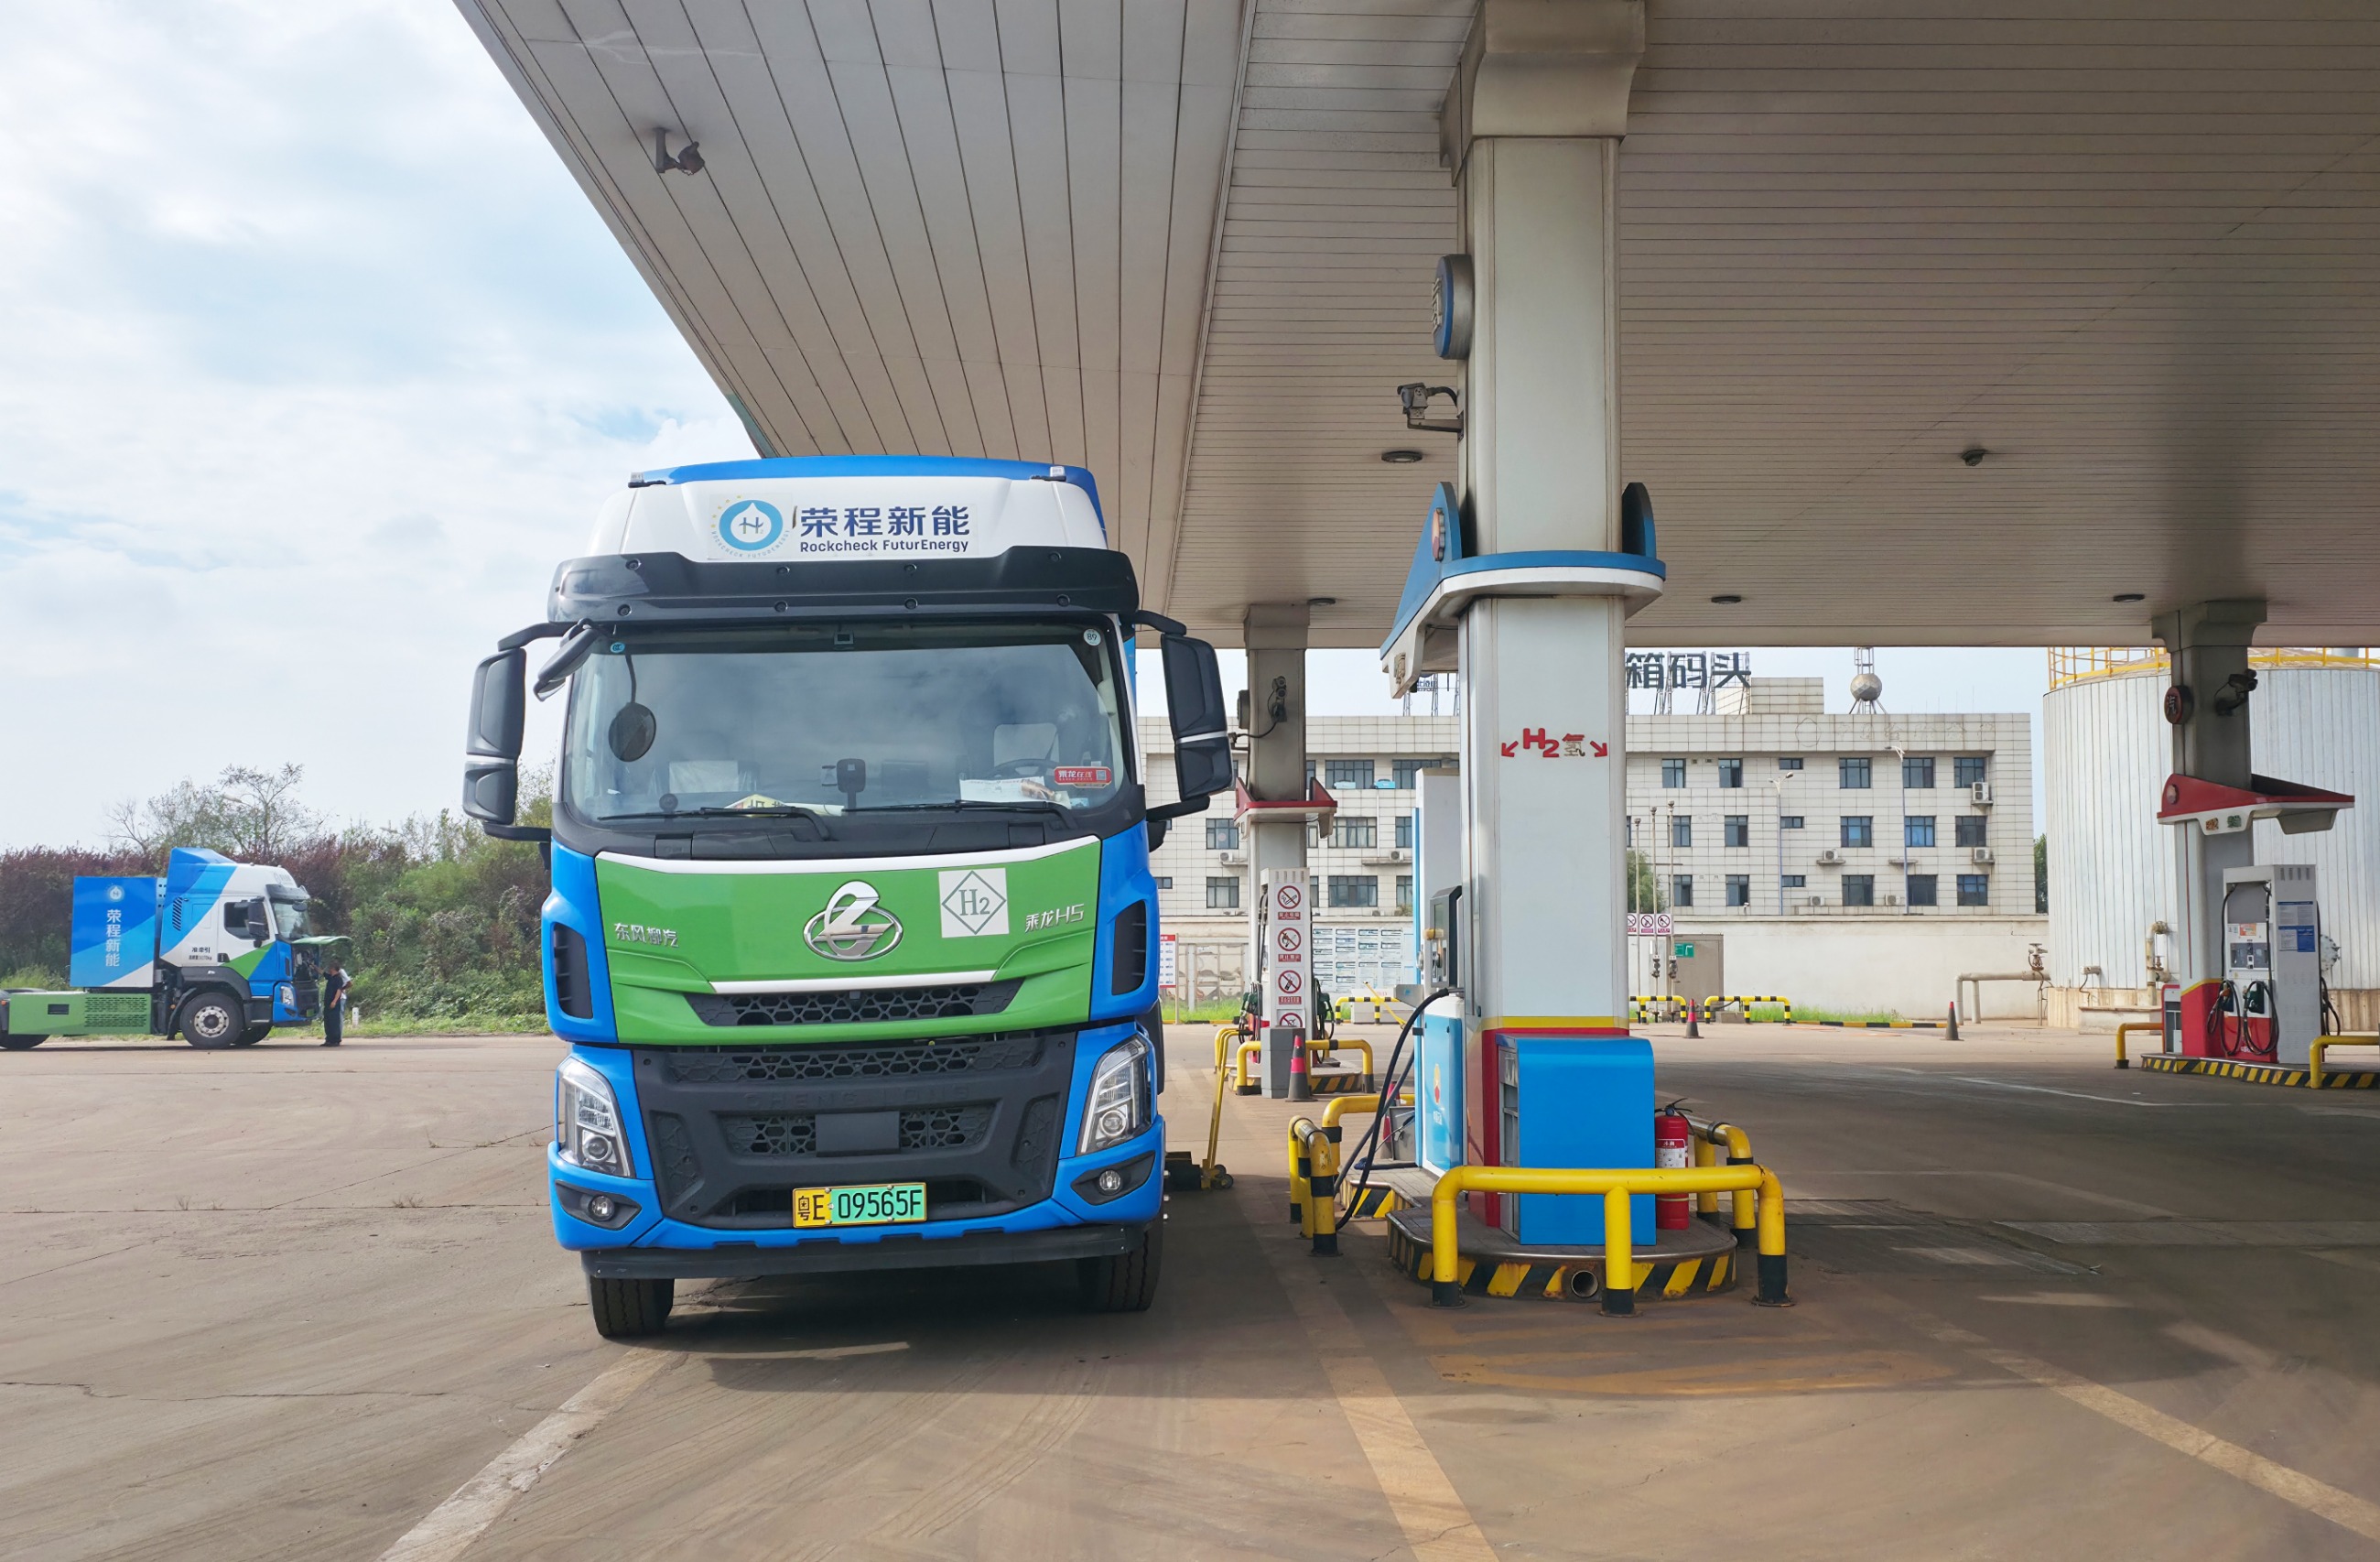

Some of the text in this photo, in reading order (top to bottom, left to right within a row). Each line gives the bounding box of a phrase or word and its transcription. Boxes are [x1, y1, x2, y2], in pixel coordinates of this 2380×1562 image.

[799, 505, 970, 538] 荣程新能
[800, 538, 968, 553] Rockcheck FuturEnergy
[1087, 633, 1098, 641] 89
[1626, 652, 1752, 689] 箱码头
[958, 888, 990, 917] H2
[105, 908, 122, 967] 荣程新能
[614, 922, 679, 948] 东风柳汽
[797, 1189, 923, 1221] 粤E 09565F
